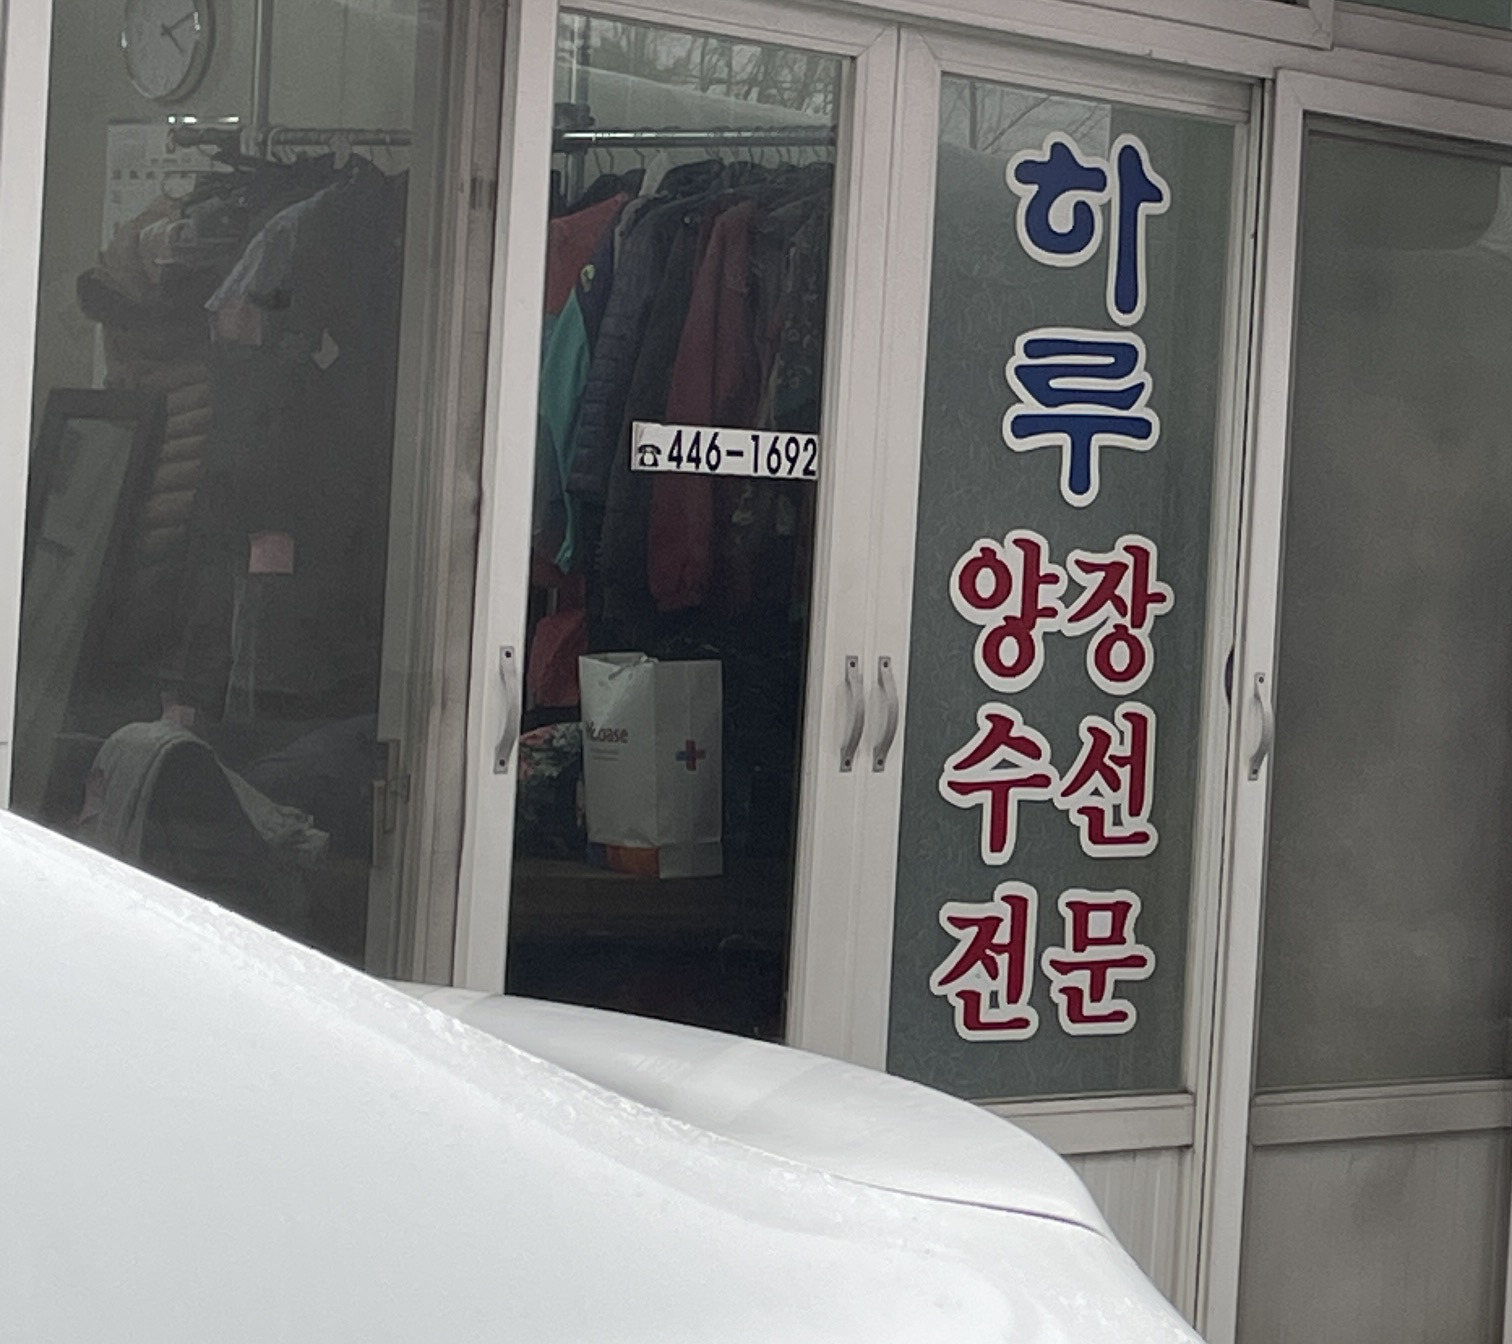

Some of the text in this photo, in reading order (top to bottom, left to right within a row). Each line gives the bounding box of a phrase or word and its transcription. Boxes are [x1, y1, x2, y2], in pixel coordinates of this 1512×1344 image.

[1006, 136, 1168, 503] 하루
[667, 430, 817, 476] 446-1692
[953, 531, 1171, 690] 양장
[941, 705, 1155, 861] 수선
[934, 884, 1153, 1036] 전문
